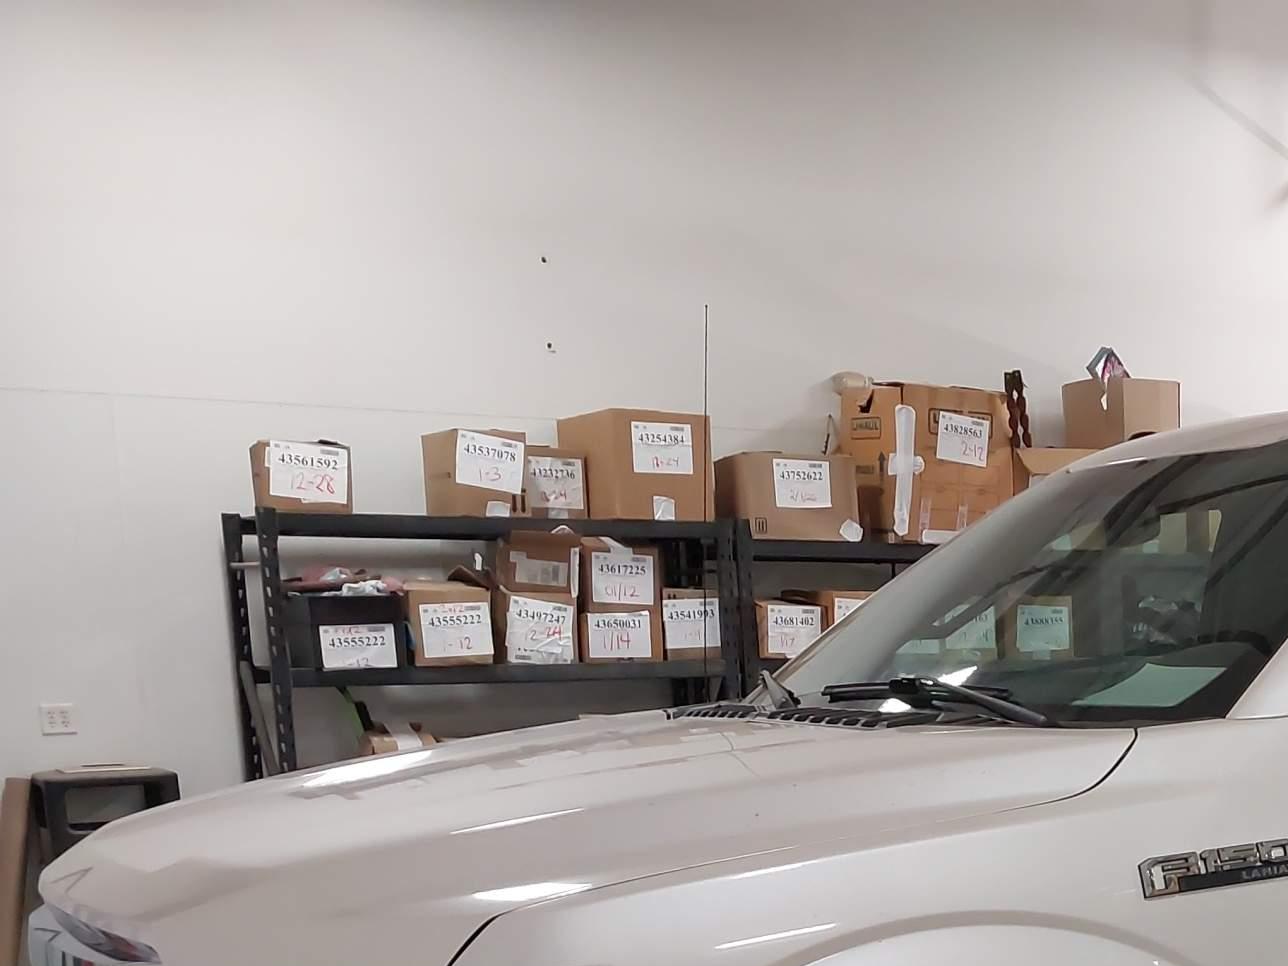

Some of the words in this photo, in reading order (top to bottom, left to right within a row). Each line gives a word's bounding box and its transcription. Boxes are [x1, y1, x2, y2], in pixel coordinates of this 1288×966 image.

[943, 422, 984, 439] 43828563
[463, 442, 517, 462] 43537078
[278, 453, 339, 470] 43561592
[779, 469, 824, 481] 43752622
[598, 563, 647, 576] 43617225
[427, 613, 483, 628] 43555222
[515, 608, 567, 625] 43497247
[772, 614, 816, 627] 43681402
[593, 618, 642, 630] 43650031
[328, 635, 387, 649] 43555222
